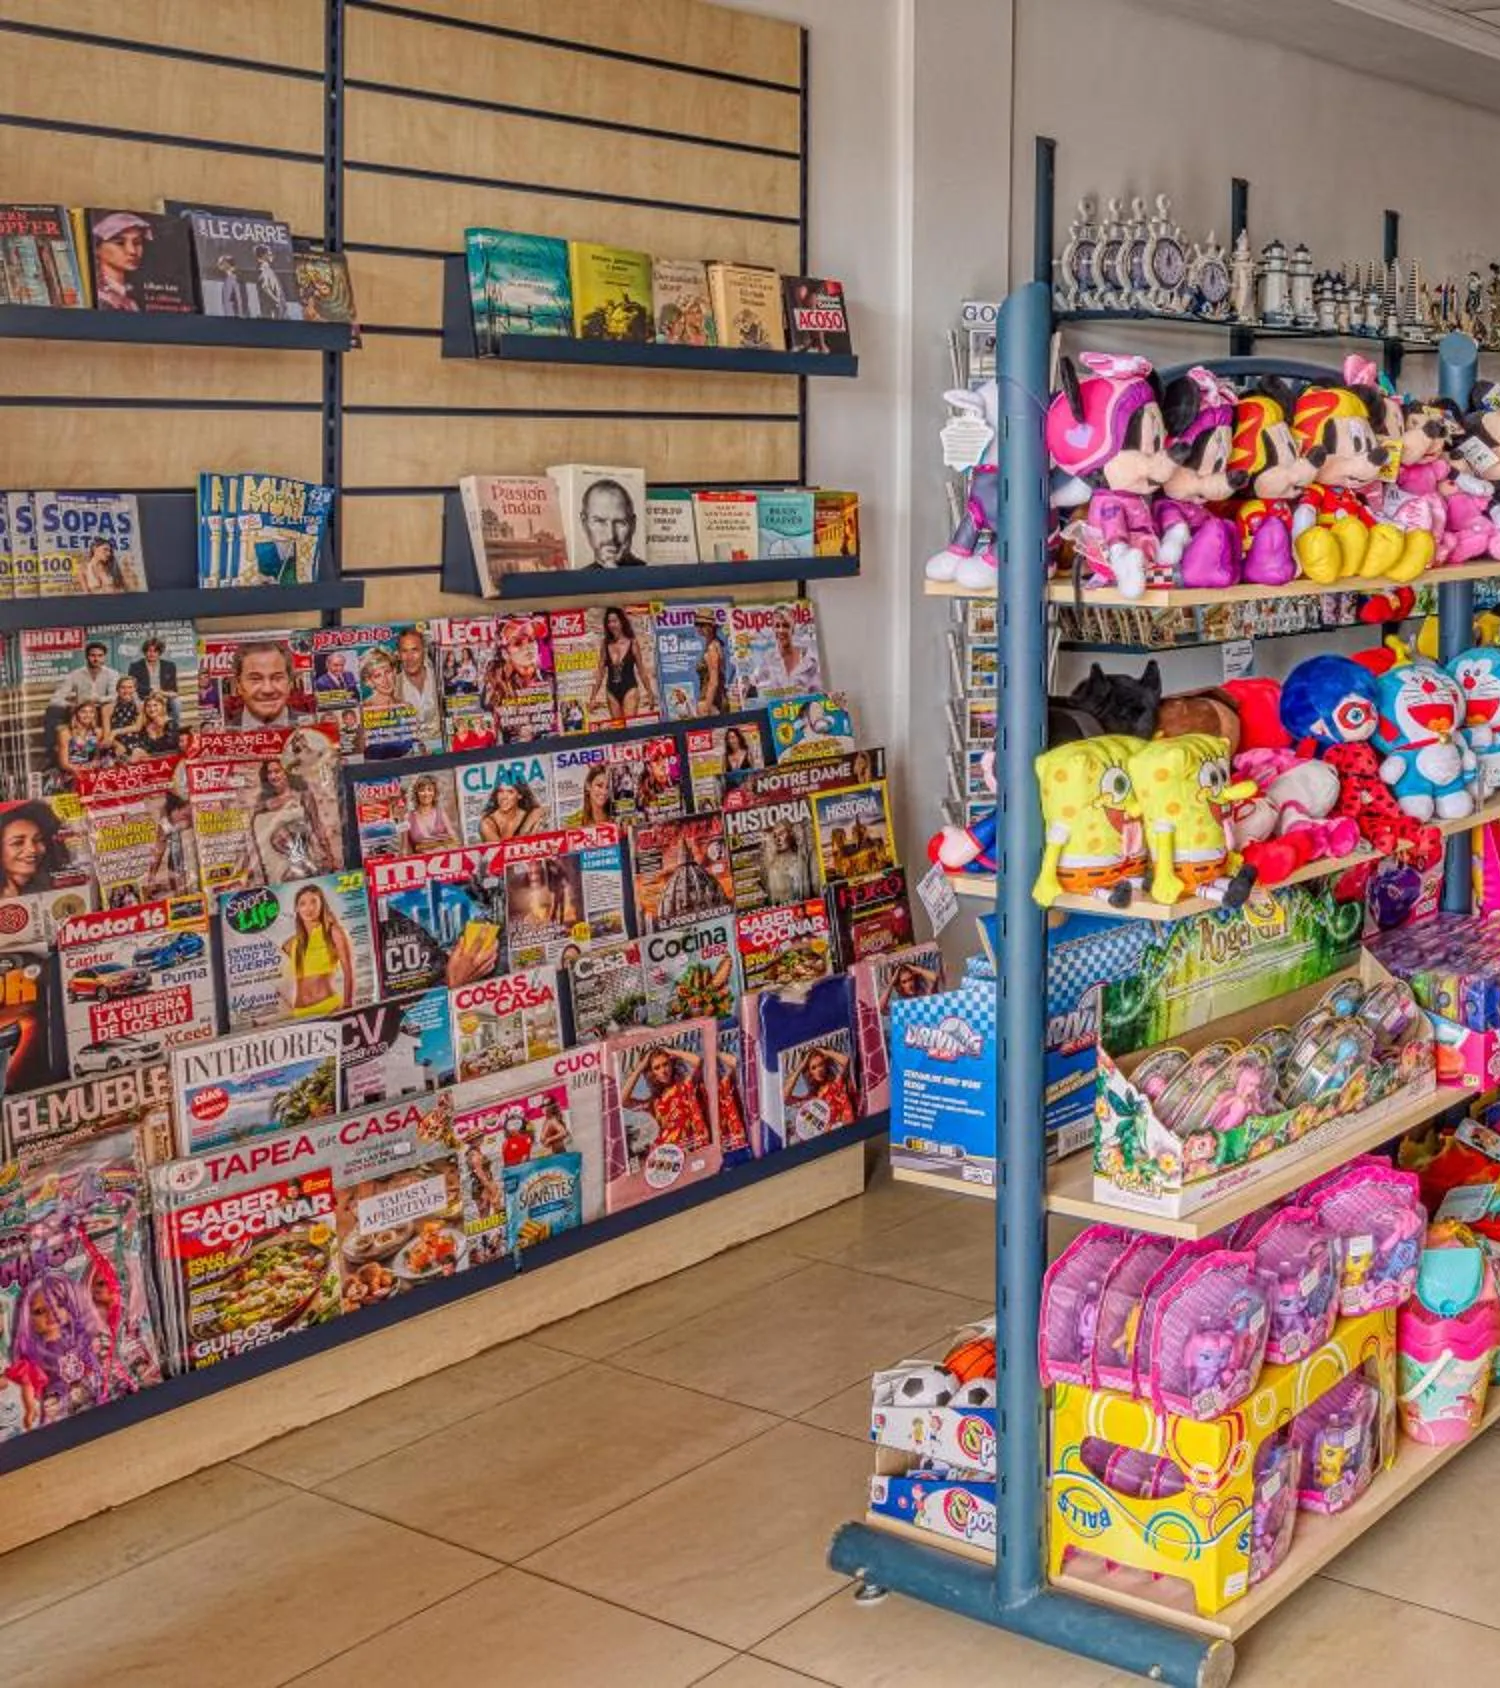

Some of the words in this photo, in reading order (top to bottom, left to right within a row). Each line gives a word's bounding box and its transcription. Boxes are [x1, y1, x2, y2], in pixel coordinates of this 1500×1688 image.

[799, 310, 843, 330] ACOSO
[42, 503, 132, 534] SOPAS
[55, 535, 130, 551] LETAS
[41, 558, 73, 573] 100
[22, 629, 81, 648] ¡HOLA!
[200, 732, 284, 748] PASARELA
[193, 765, 229, 785] DIEZ
[463, 757, 546, 793] CLARA
[756, 769, 808, 793] NOTRE
[810, 762, 852, 783] DAME
[725, 799, 811, 835] HISTORIA
[824, 795, 878, 821] HISTORIA
[504, 836, 563, 858] muy
[375, 845, 502, 887] muy
[64, 914, 138, 943] Motor
[141, 908, 166, 929] 16
[739, 908, 795, 935] SABER
[751, 915, 826, 947] COCINAR
[385, 942, 433, 974] CO2
[647, 925, 728, 963] Cocina
[161, 967, 208, 985] Puma
[455, 974, 527, 1010] COSAS
[95, 1009, 120, 1027] LA
[121, 995, 188, 1021] GUERRA
[493, 985, 555, 1017] CASA
[96, 1022, 120, 1041] DE
[121, 1016, 154, 1036] LOS
[155, 1007, 189, 1028] SUV
[183, 1026, 338, 1084] INTERIORES
[10, 1098, 48, 1139] EL
[48, 1065, 170, 1129] MUEBLE
[205, 1135, 315, 1184] TAPEA
[338, 1104, 424, 1145] CASA
[180, 1188, 281, 1234] SABER
[200, 1192, 332, 1247] COCINAR
[195, 1319, 274, 1358] GUISOS
[1056, 1490, 1113, 1532] BALLS
